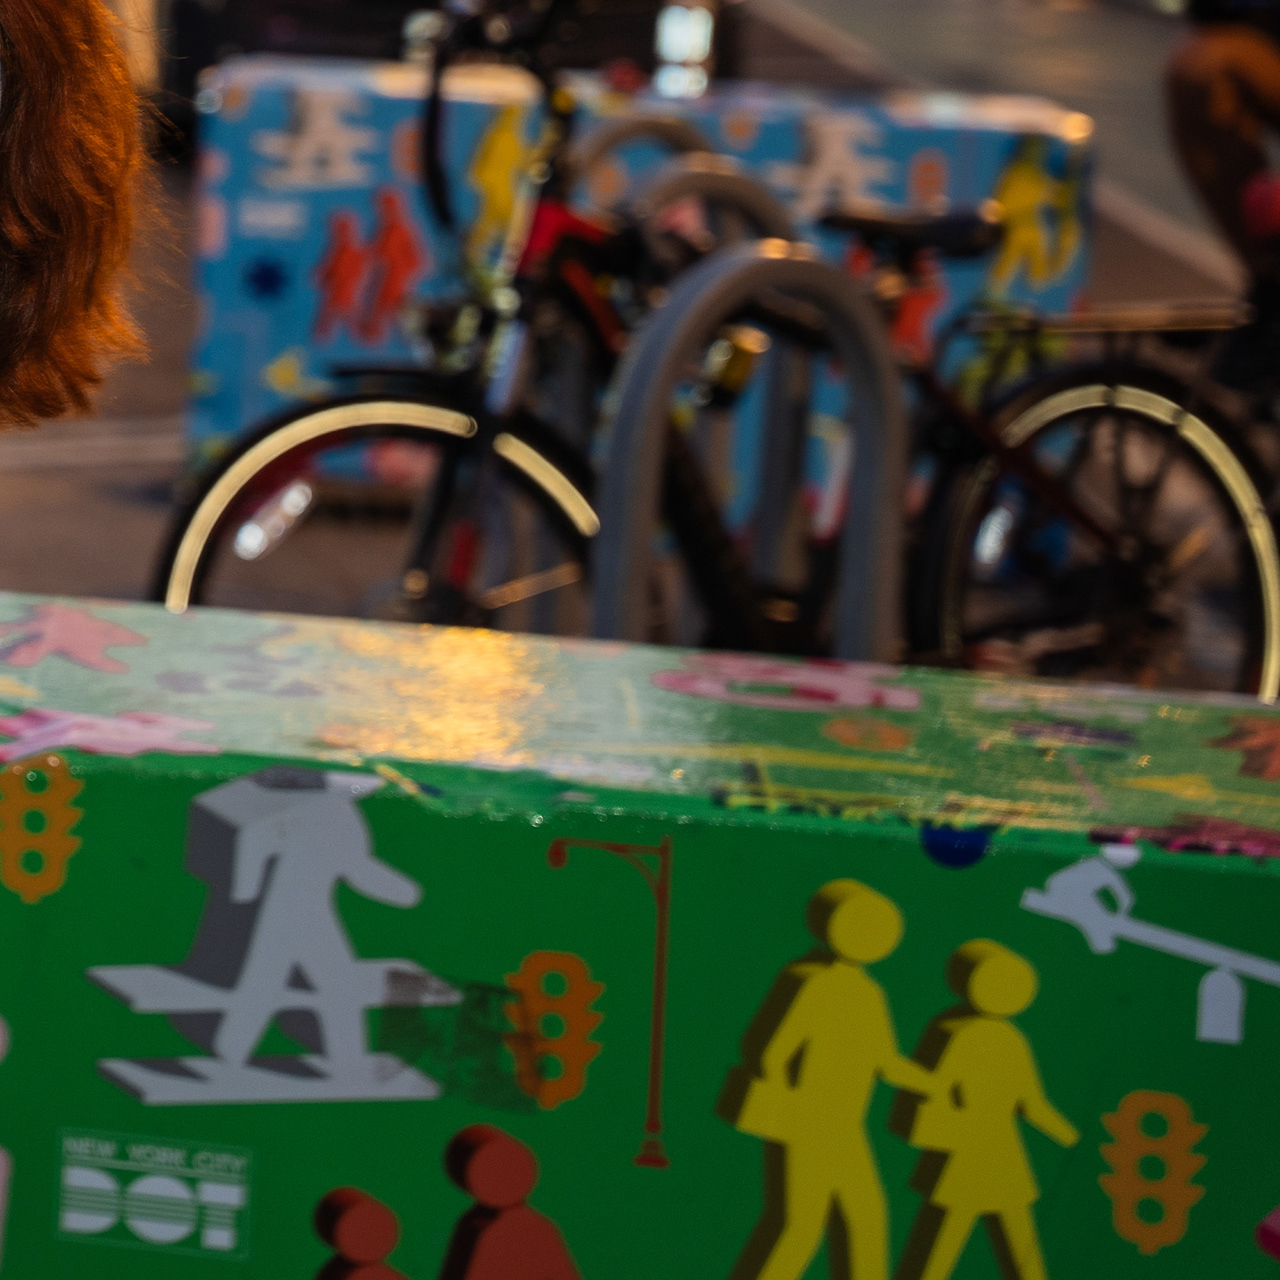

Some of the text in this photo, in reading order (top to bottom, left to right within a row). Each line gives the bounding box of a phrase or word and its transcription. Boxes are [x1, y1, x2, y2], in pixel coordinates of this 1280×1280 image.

[64, 1137, 248, 1173] NEW YORK CITY
[60, 1167, 246, 1250] DOT
